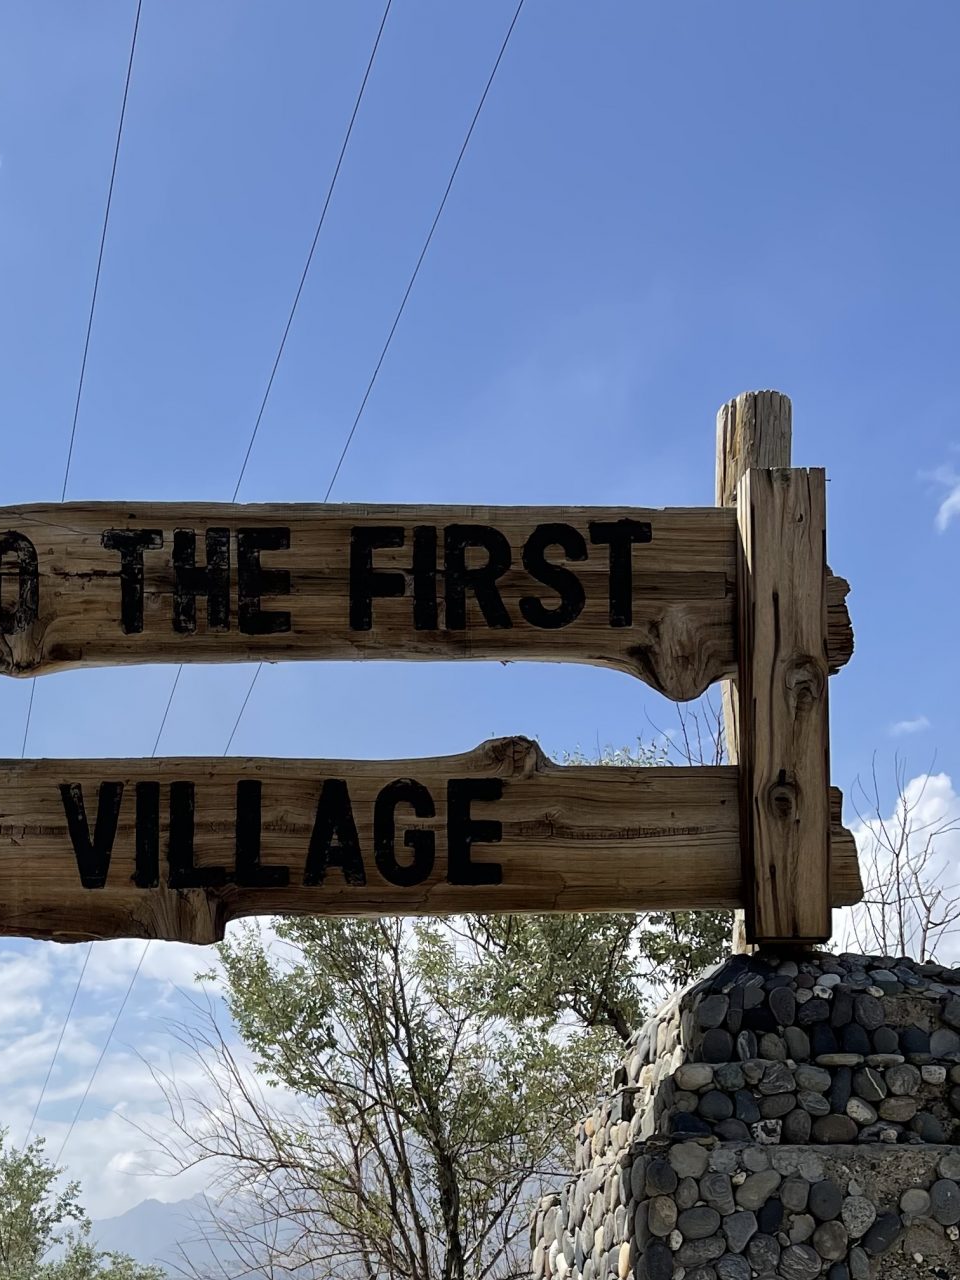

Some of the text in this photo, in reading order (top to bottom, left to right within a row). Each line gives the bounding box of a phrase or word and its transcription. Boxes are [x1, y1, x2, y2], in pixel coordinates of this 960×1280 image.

[103, 526, 291, 636] THE
[349, 518, 652, 632] FIRST
[60, 778, 503, 890] VILLAGE
